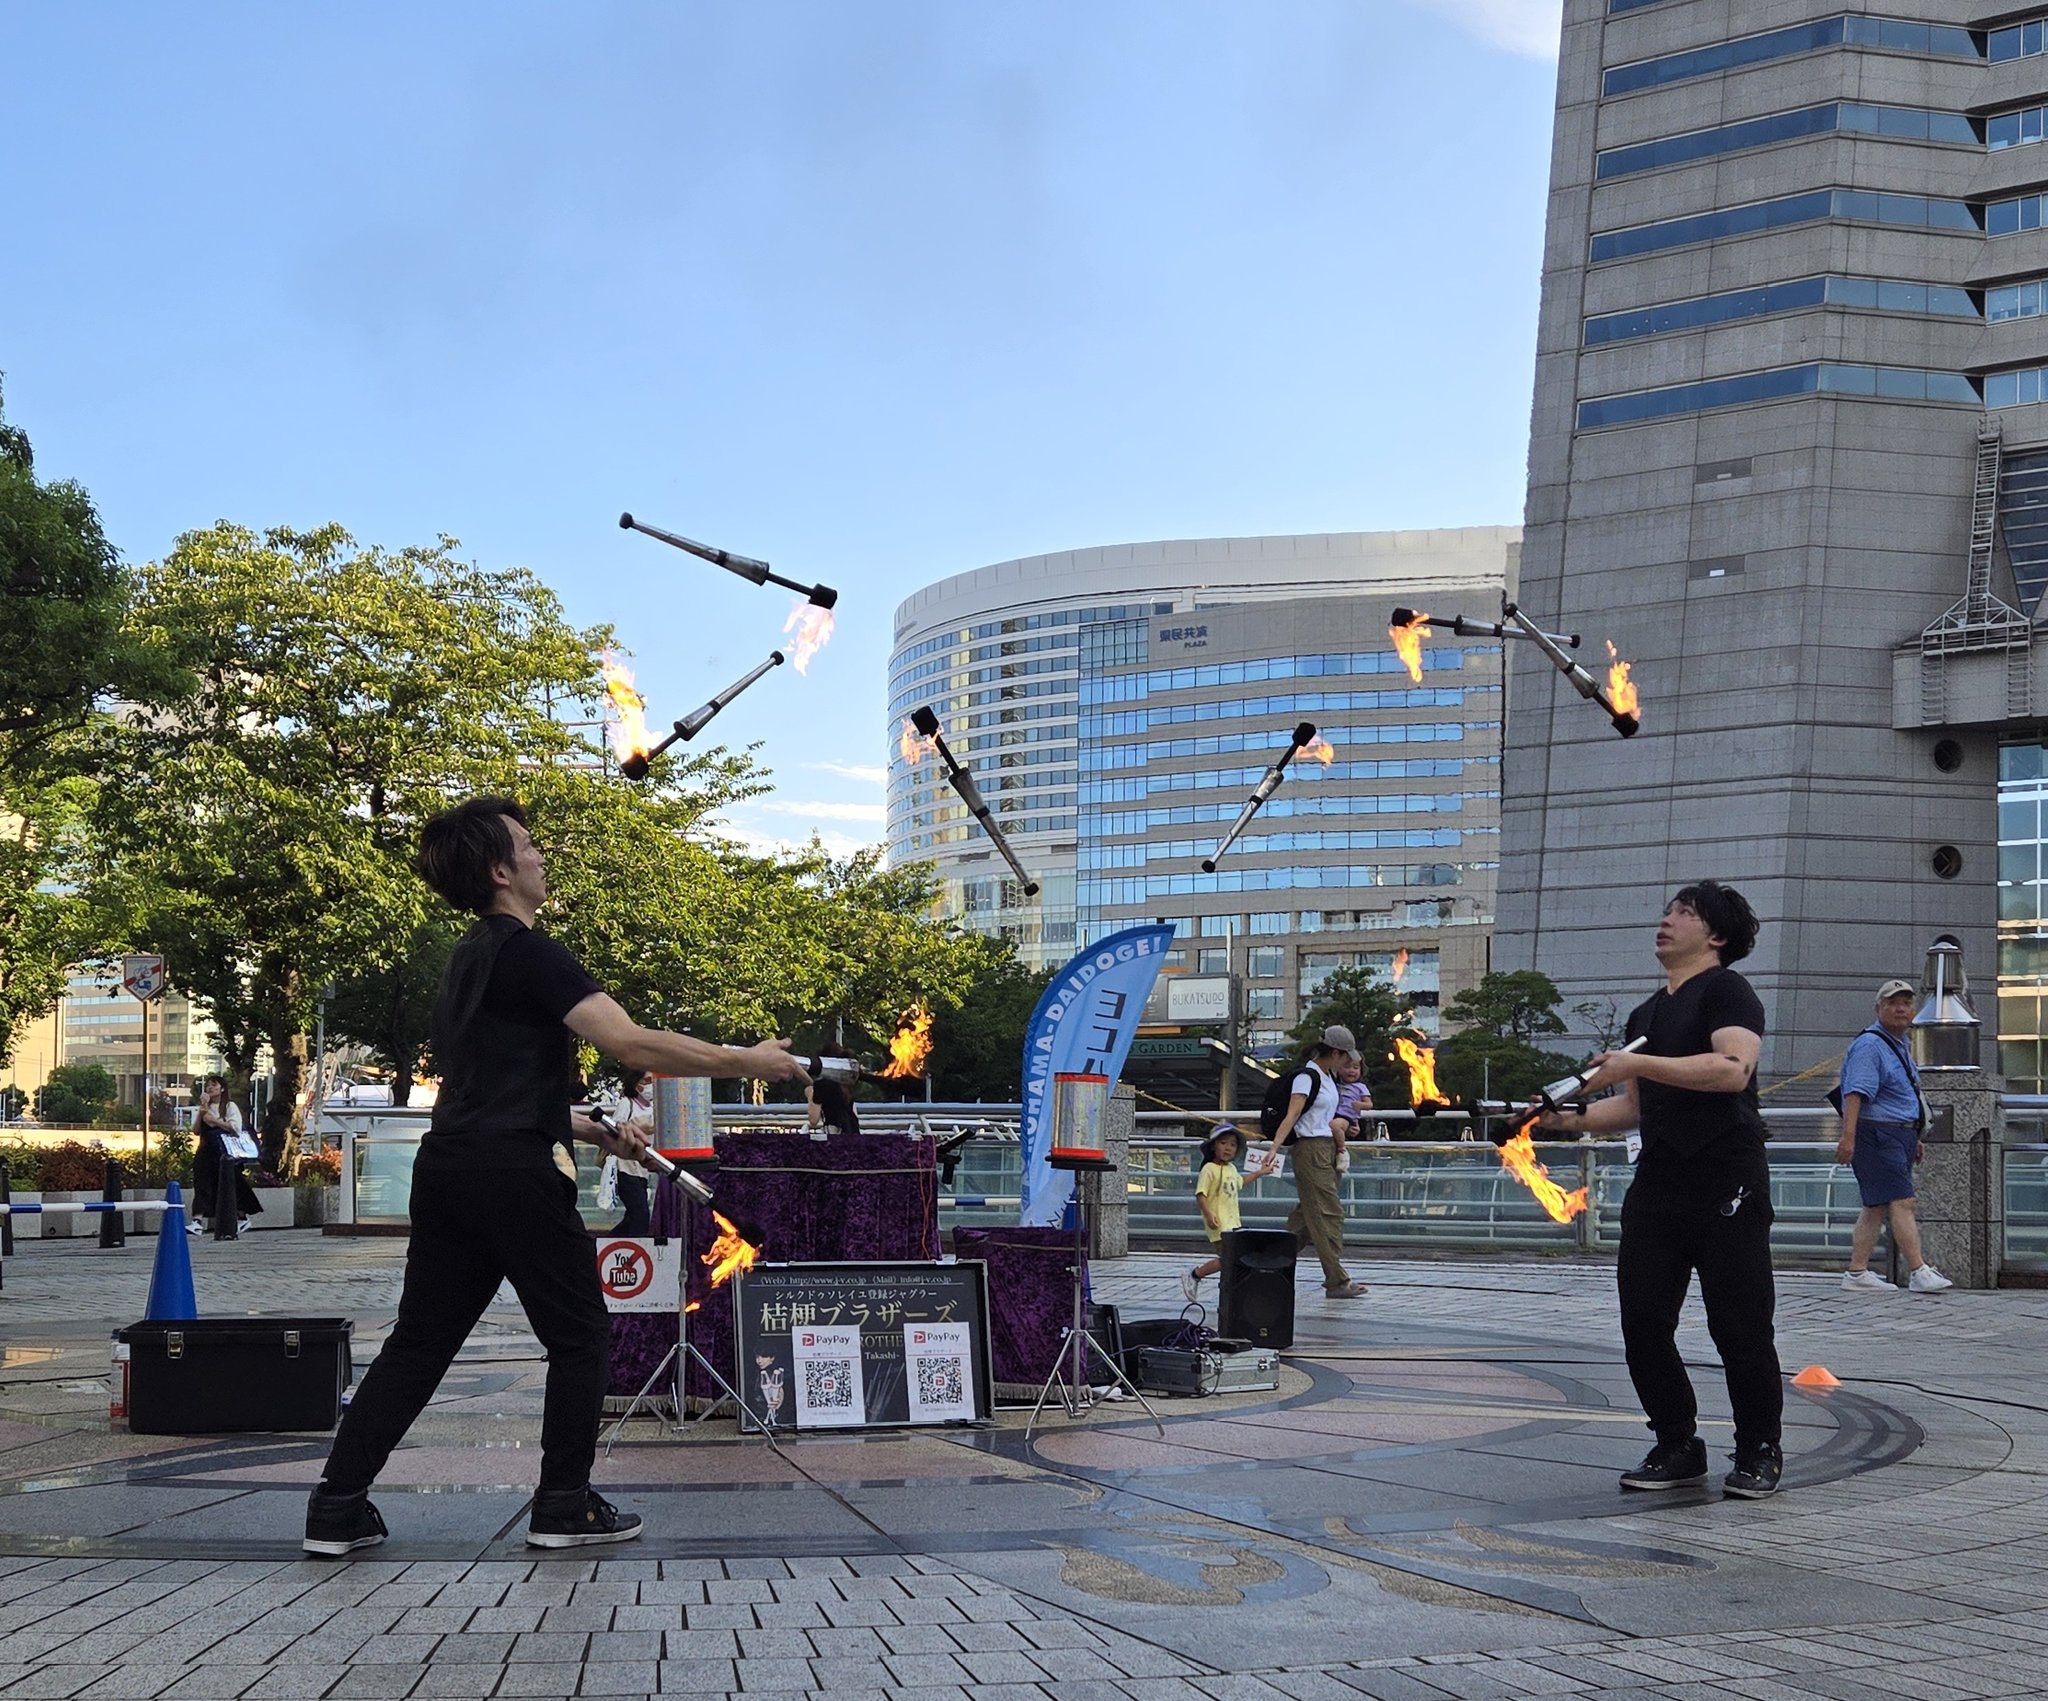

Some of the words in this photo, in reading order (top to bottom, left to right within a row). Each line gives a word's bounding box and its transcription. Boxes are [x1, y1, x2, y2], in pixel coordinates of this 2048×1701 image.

[1184, 640, 1207, 648] PLAZA
[1172, 992, 1225, 1006] BUKATSUDO
[1138, 1043, 1193, 1054] GARDEN
[611, 1269, 636, 1284] Tube
[759, 1299, 957, 1332] 桔梗ブラザーズ
[816, 1335, 850, 1346] PayPay
[927, 1332, 960, 1342] PayPay
